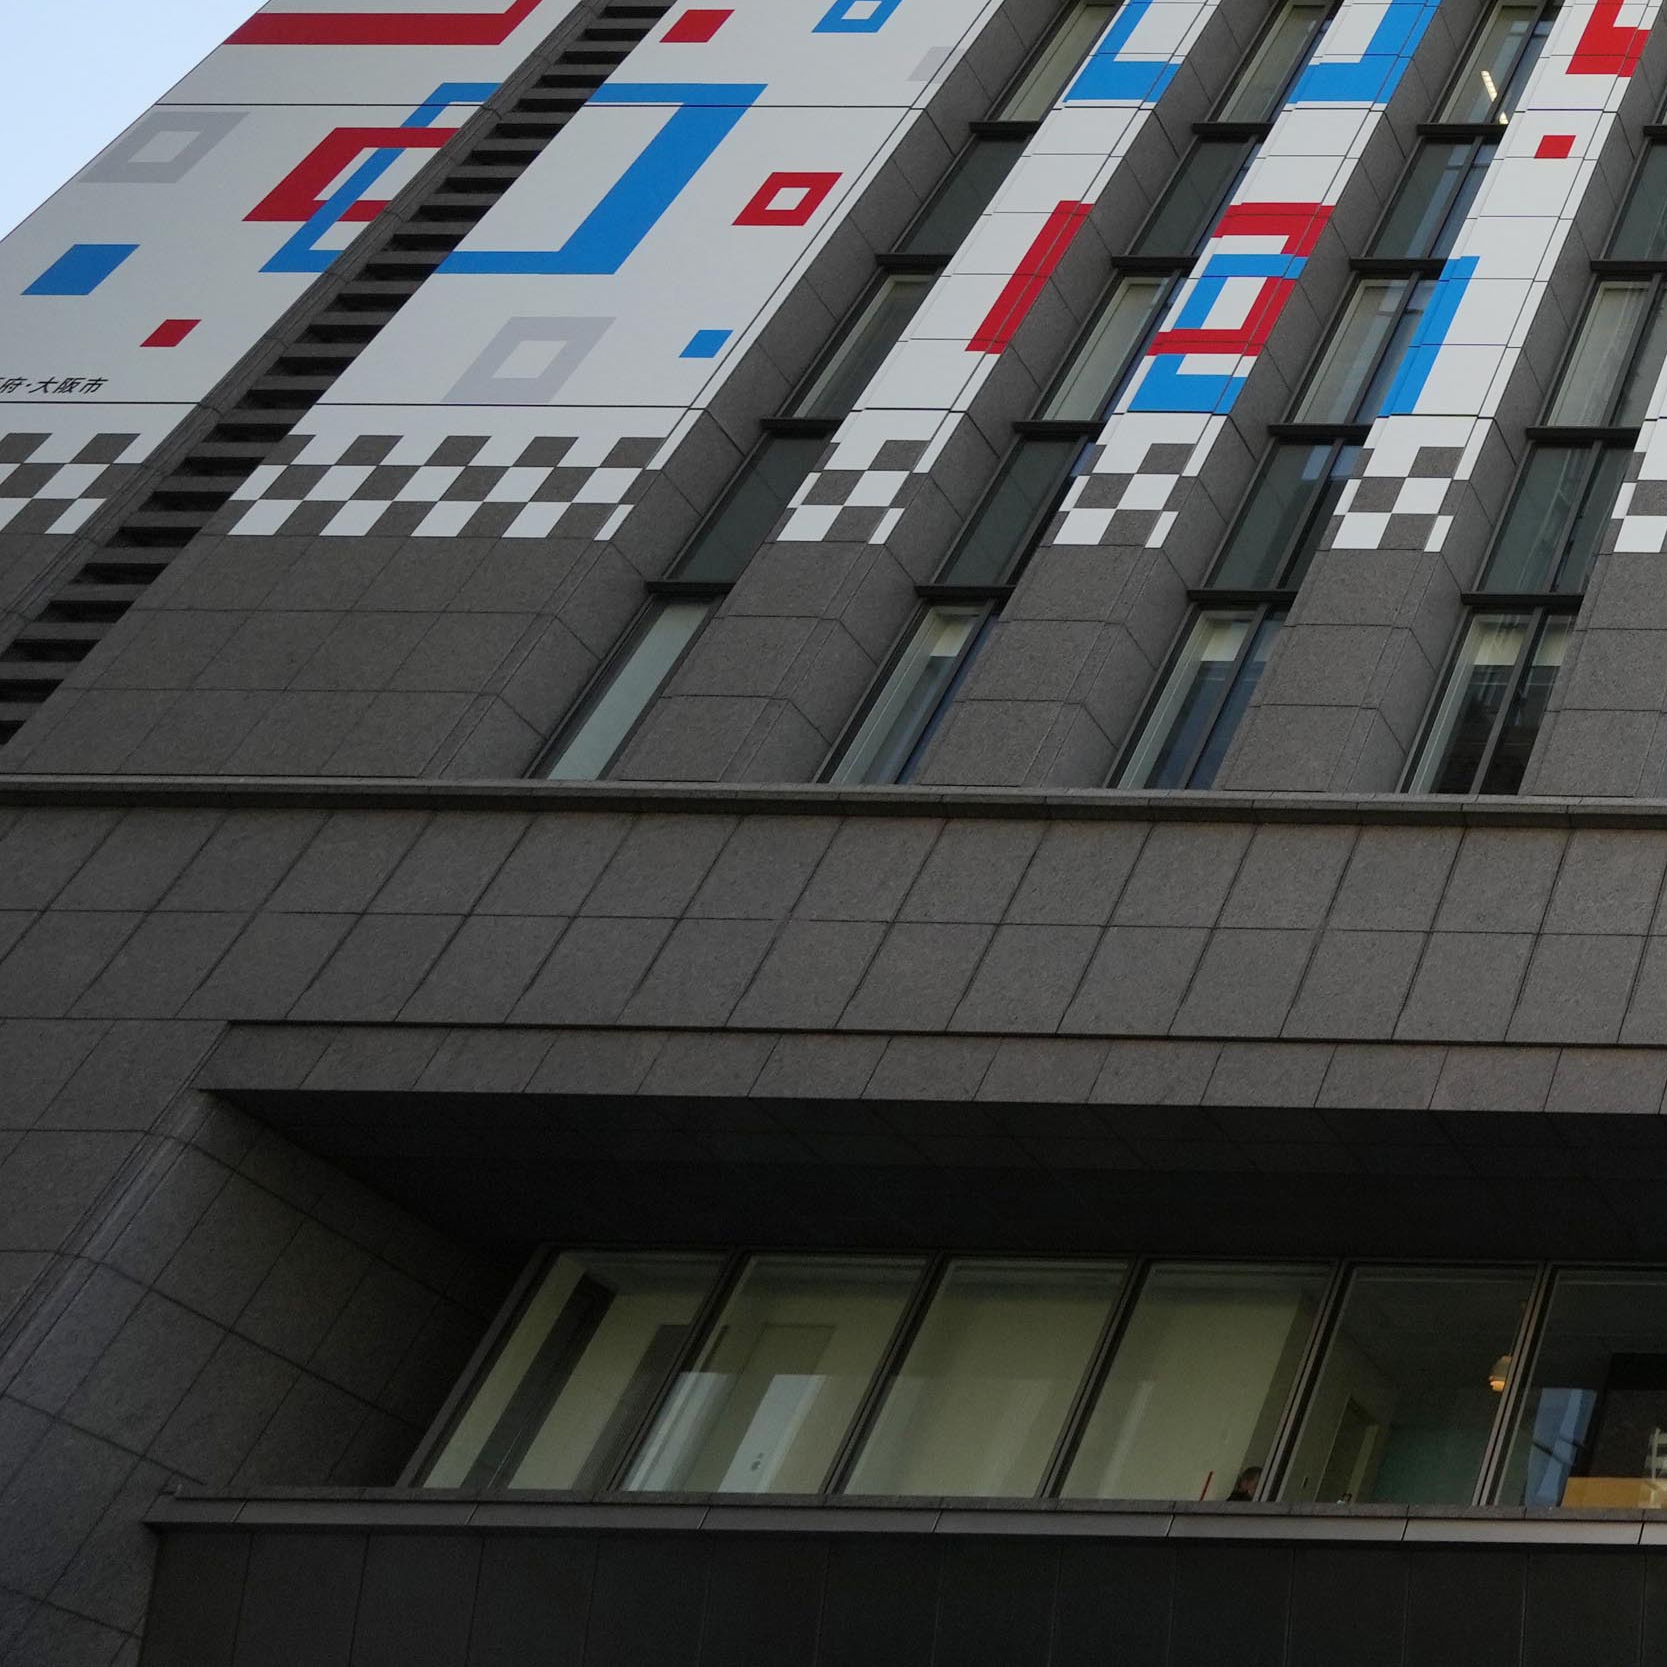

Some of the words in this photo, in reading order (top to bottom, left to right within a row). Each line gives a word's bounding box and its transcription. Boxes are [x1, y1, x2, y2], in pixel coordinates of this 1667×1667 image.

[0, 376, 109, 394] 府・大阪市
